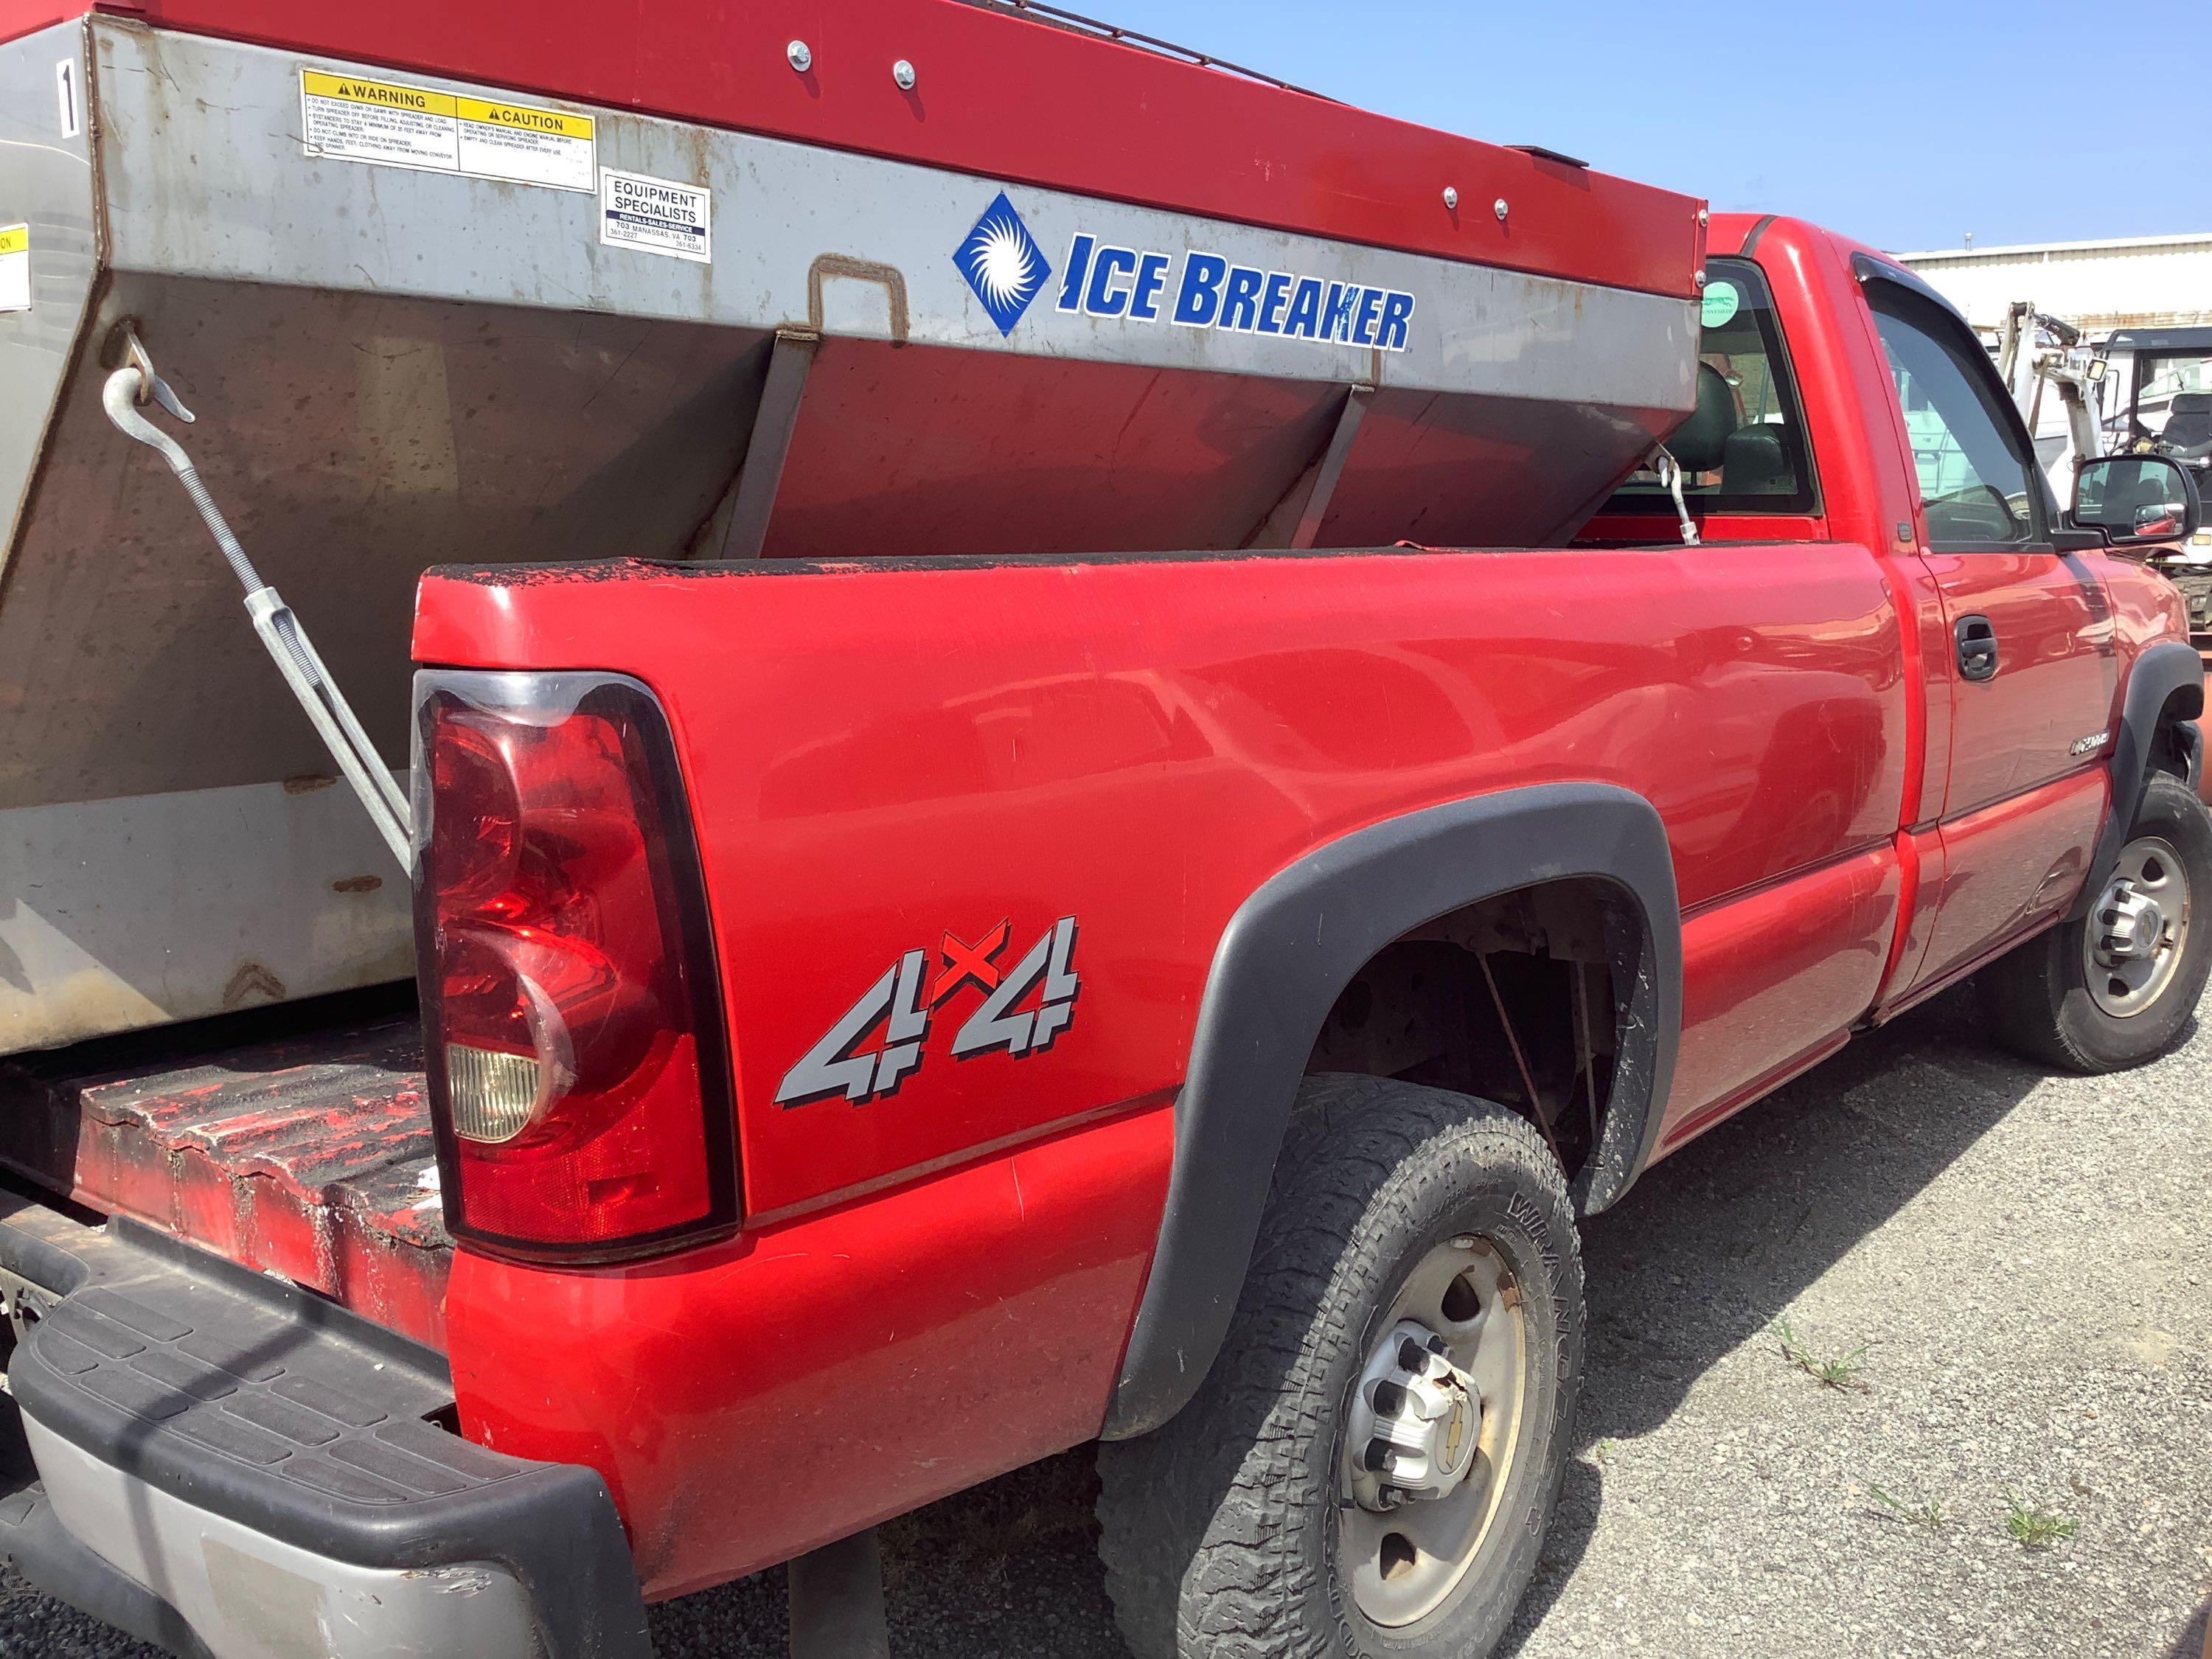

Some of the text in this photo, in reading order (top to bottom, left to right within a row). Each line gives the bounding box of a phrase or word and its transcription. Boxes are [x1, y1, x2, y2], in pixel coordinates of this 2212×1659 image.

[63, 64, 74, 131] 1
[352, 85, 426, 108] WARNING
[502, 110, 563, 131] CAUTION
[614, 181, 697, 207] EQUIPMENT
[615, 196, 696, 223] SPECIALISTS
[616, 221, 696, 243] 703 MANASSAS, VA 703
[1055, 231, 1416, 352] ICE BREAKER
